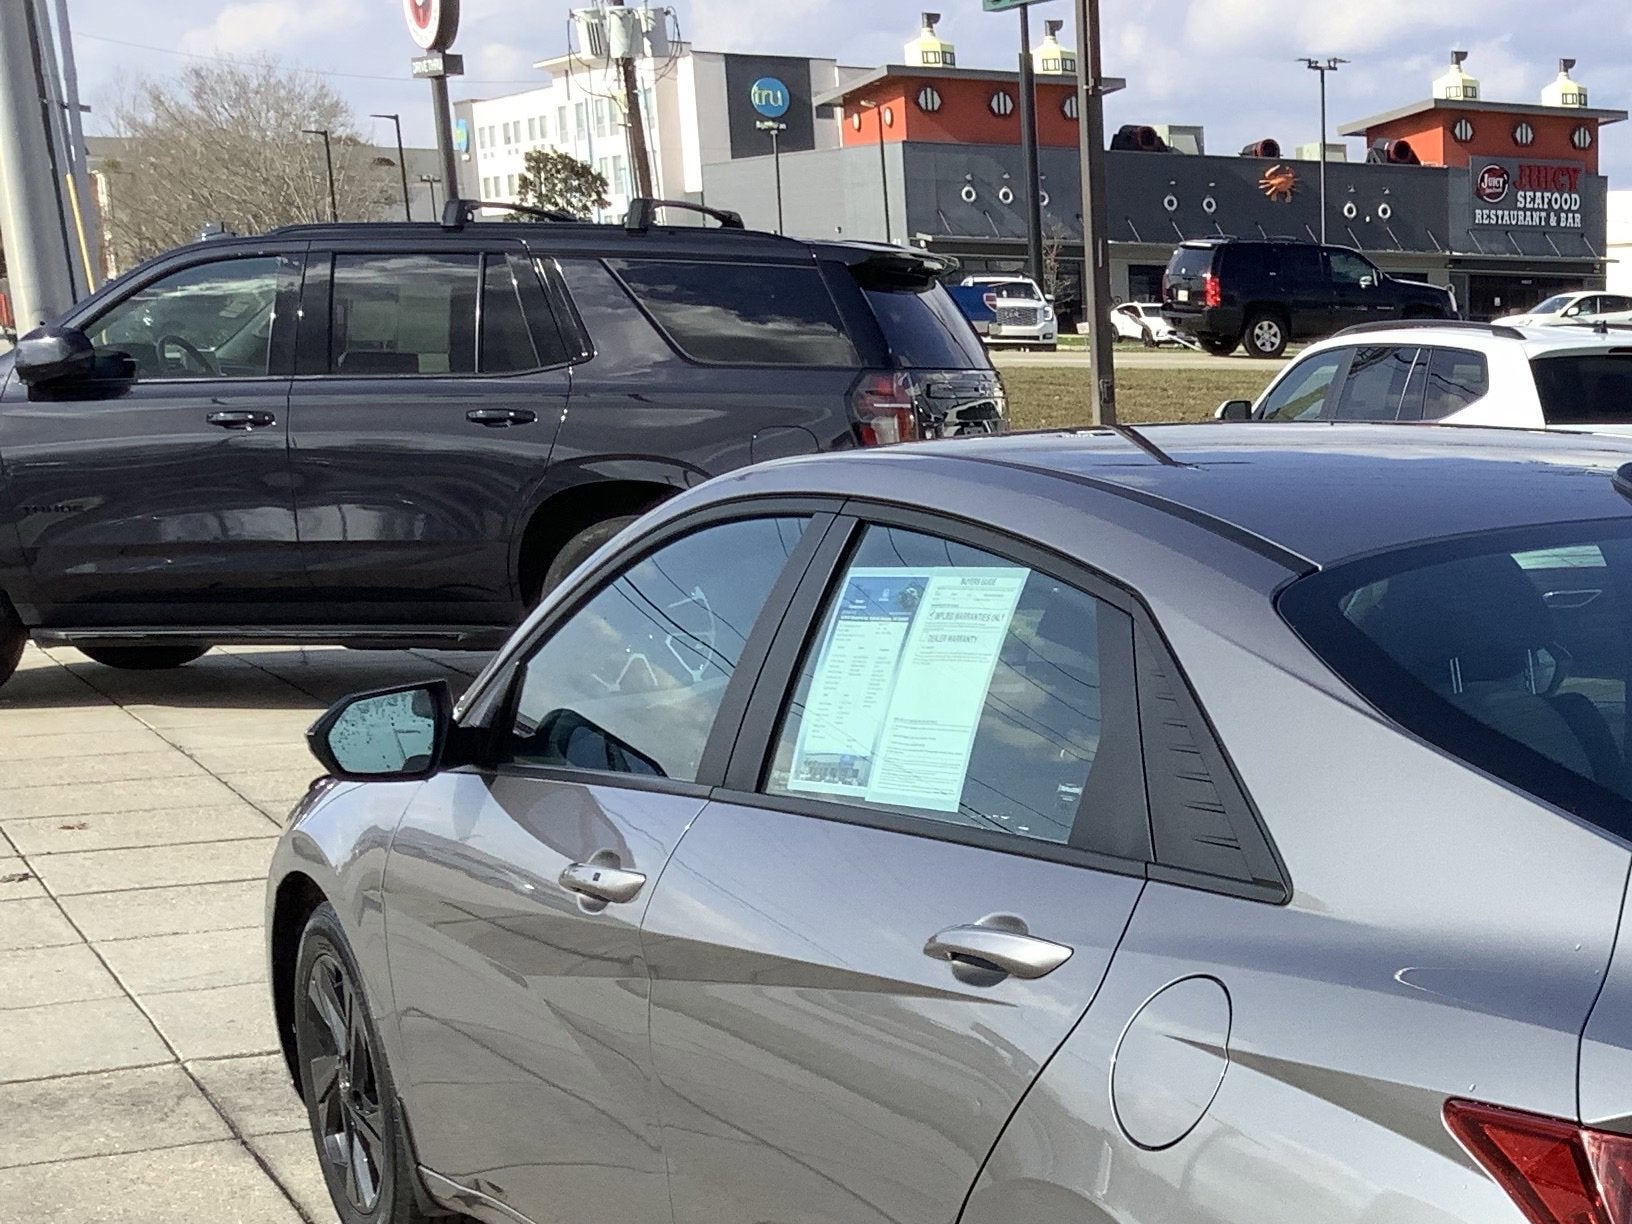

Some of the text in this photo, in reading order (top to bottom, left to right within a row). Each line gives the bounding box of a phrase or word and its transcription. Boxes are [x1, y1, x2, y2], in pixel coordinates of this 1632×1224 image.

[753, 86, 783, 106] tru
[1513, 164, 1581, 192] JUICY
[1517, 191, 1580, 210] SEAFOOD
[1475, 209, 1581, 227] RESTAURANT & BAR
